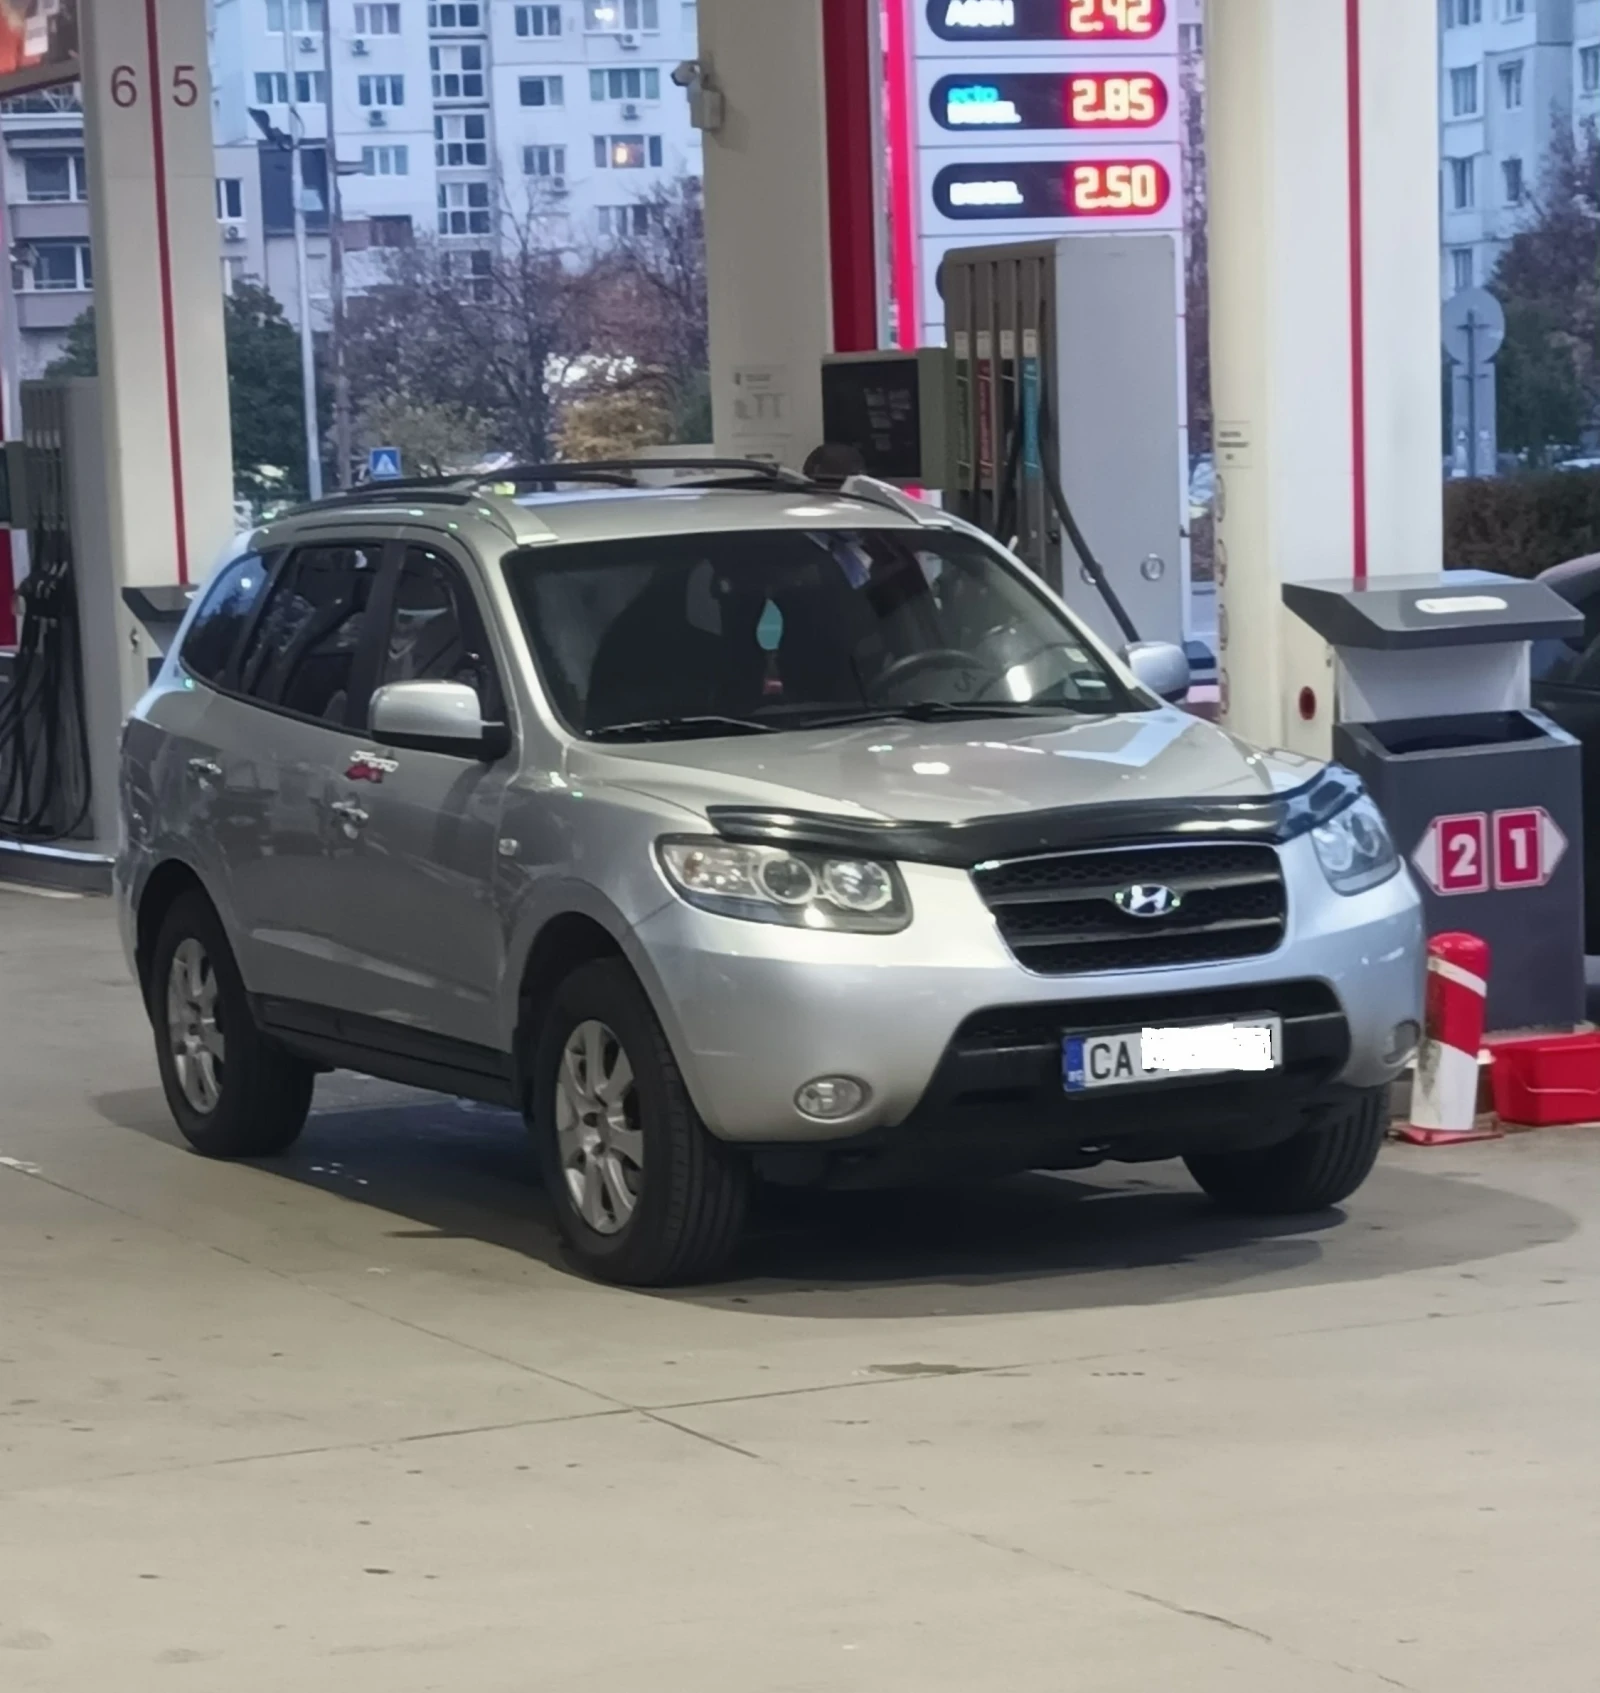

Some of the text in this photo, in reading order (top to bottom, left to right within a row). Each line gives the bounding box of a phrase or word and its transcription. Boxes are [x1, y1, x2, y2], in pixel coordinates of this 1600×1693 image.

[1069, 0, 1153, 33] 2.42
[110, 64, 138, 108] 6
[172, 65, 198, 108] 5
[1071, 78, 1155, 122] 2.85
[1073, 164, 1158, 209] 2.50
[1448, 832, 1478, 878] 2
[1508, 827, 1528, 871] 1
[1089, 1040, 1134, 1080] CA
